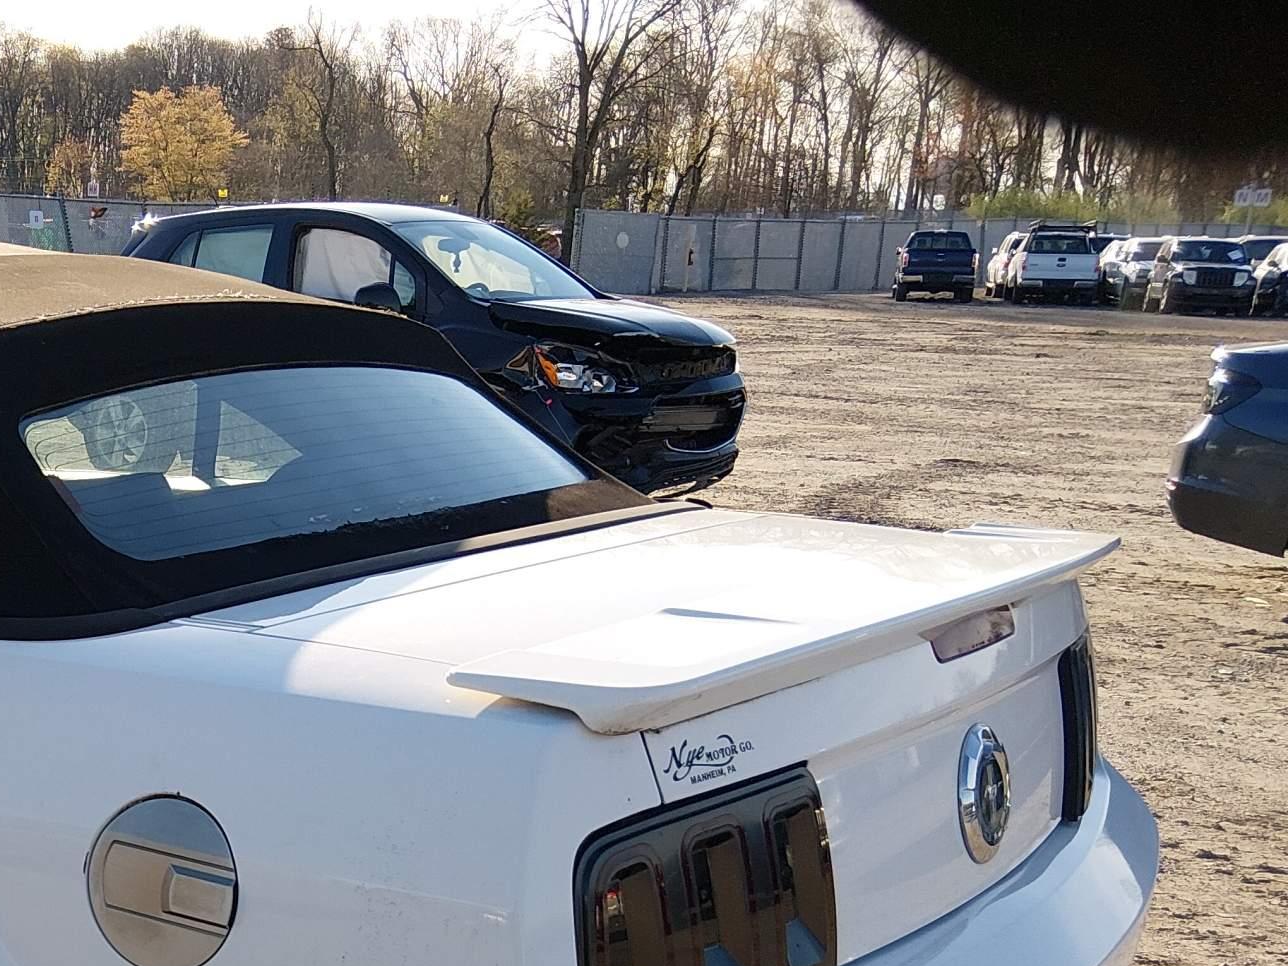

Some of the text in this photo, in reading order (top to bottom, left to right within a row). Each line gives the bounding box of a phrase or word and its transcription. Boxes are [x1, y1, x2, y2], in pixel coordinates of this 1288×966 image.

[662, 738, 705, 782] Nye
[705, 744, 739, 763] MOTOR
[726, 764, 737, 774] PA
